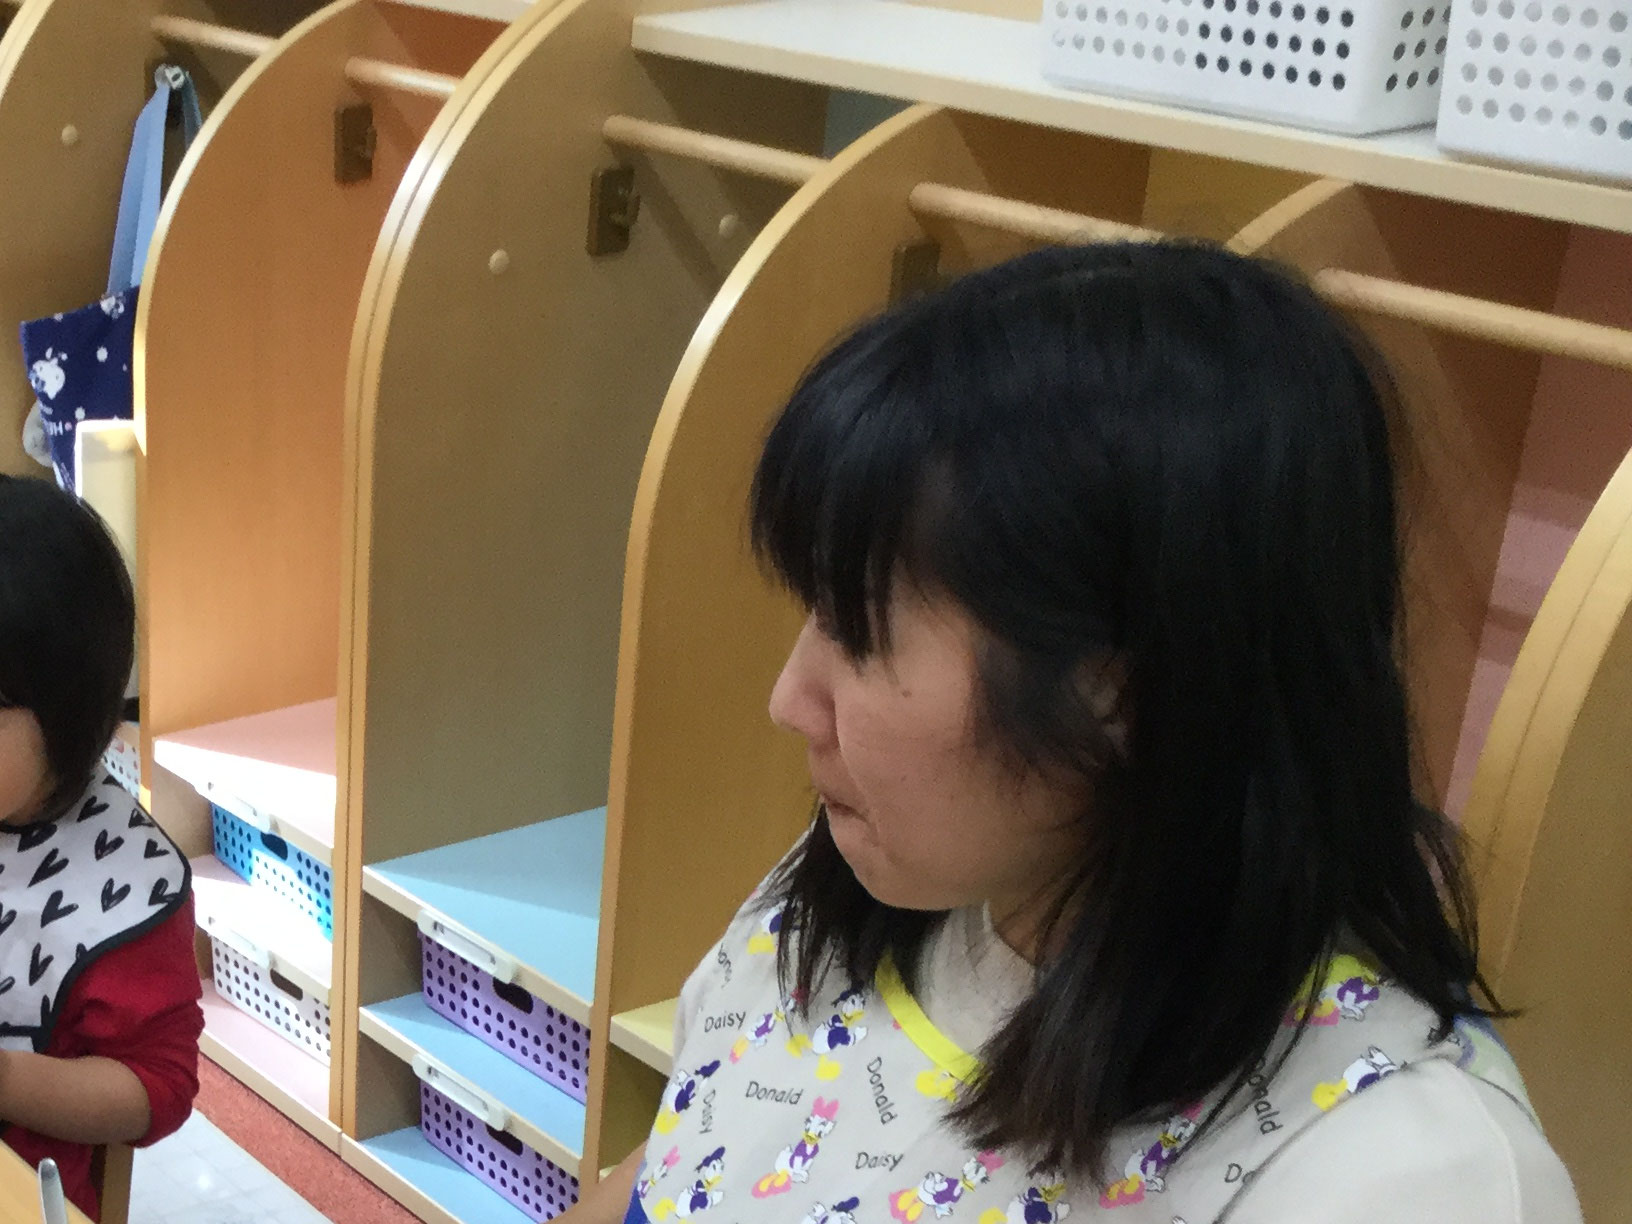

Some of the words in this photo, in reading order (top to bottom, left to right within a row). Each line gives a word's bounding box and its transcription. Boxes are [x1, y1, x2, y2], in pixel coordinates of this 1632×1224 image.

[704, 1010, 747, 1034] Daisy
[745, 1080, 804, 1106] Donald
[866, 1055, 899, 1126] Donald
[699, 1088, 717, 1135] Daisy
[854, 1151, 905, 1173] Daisy
